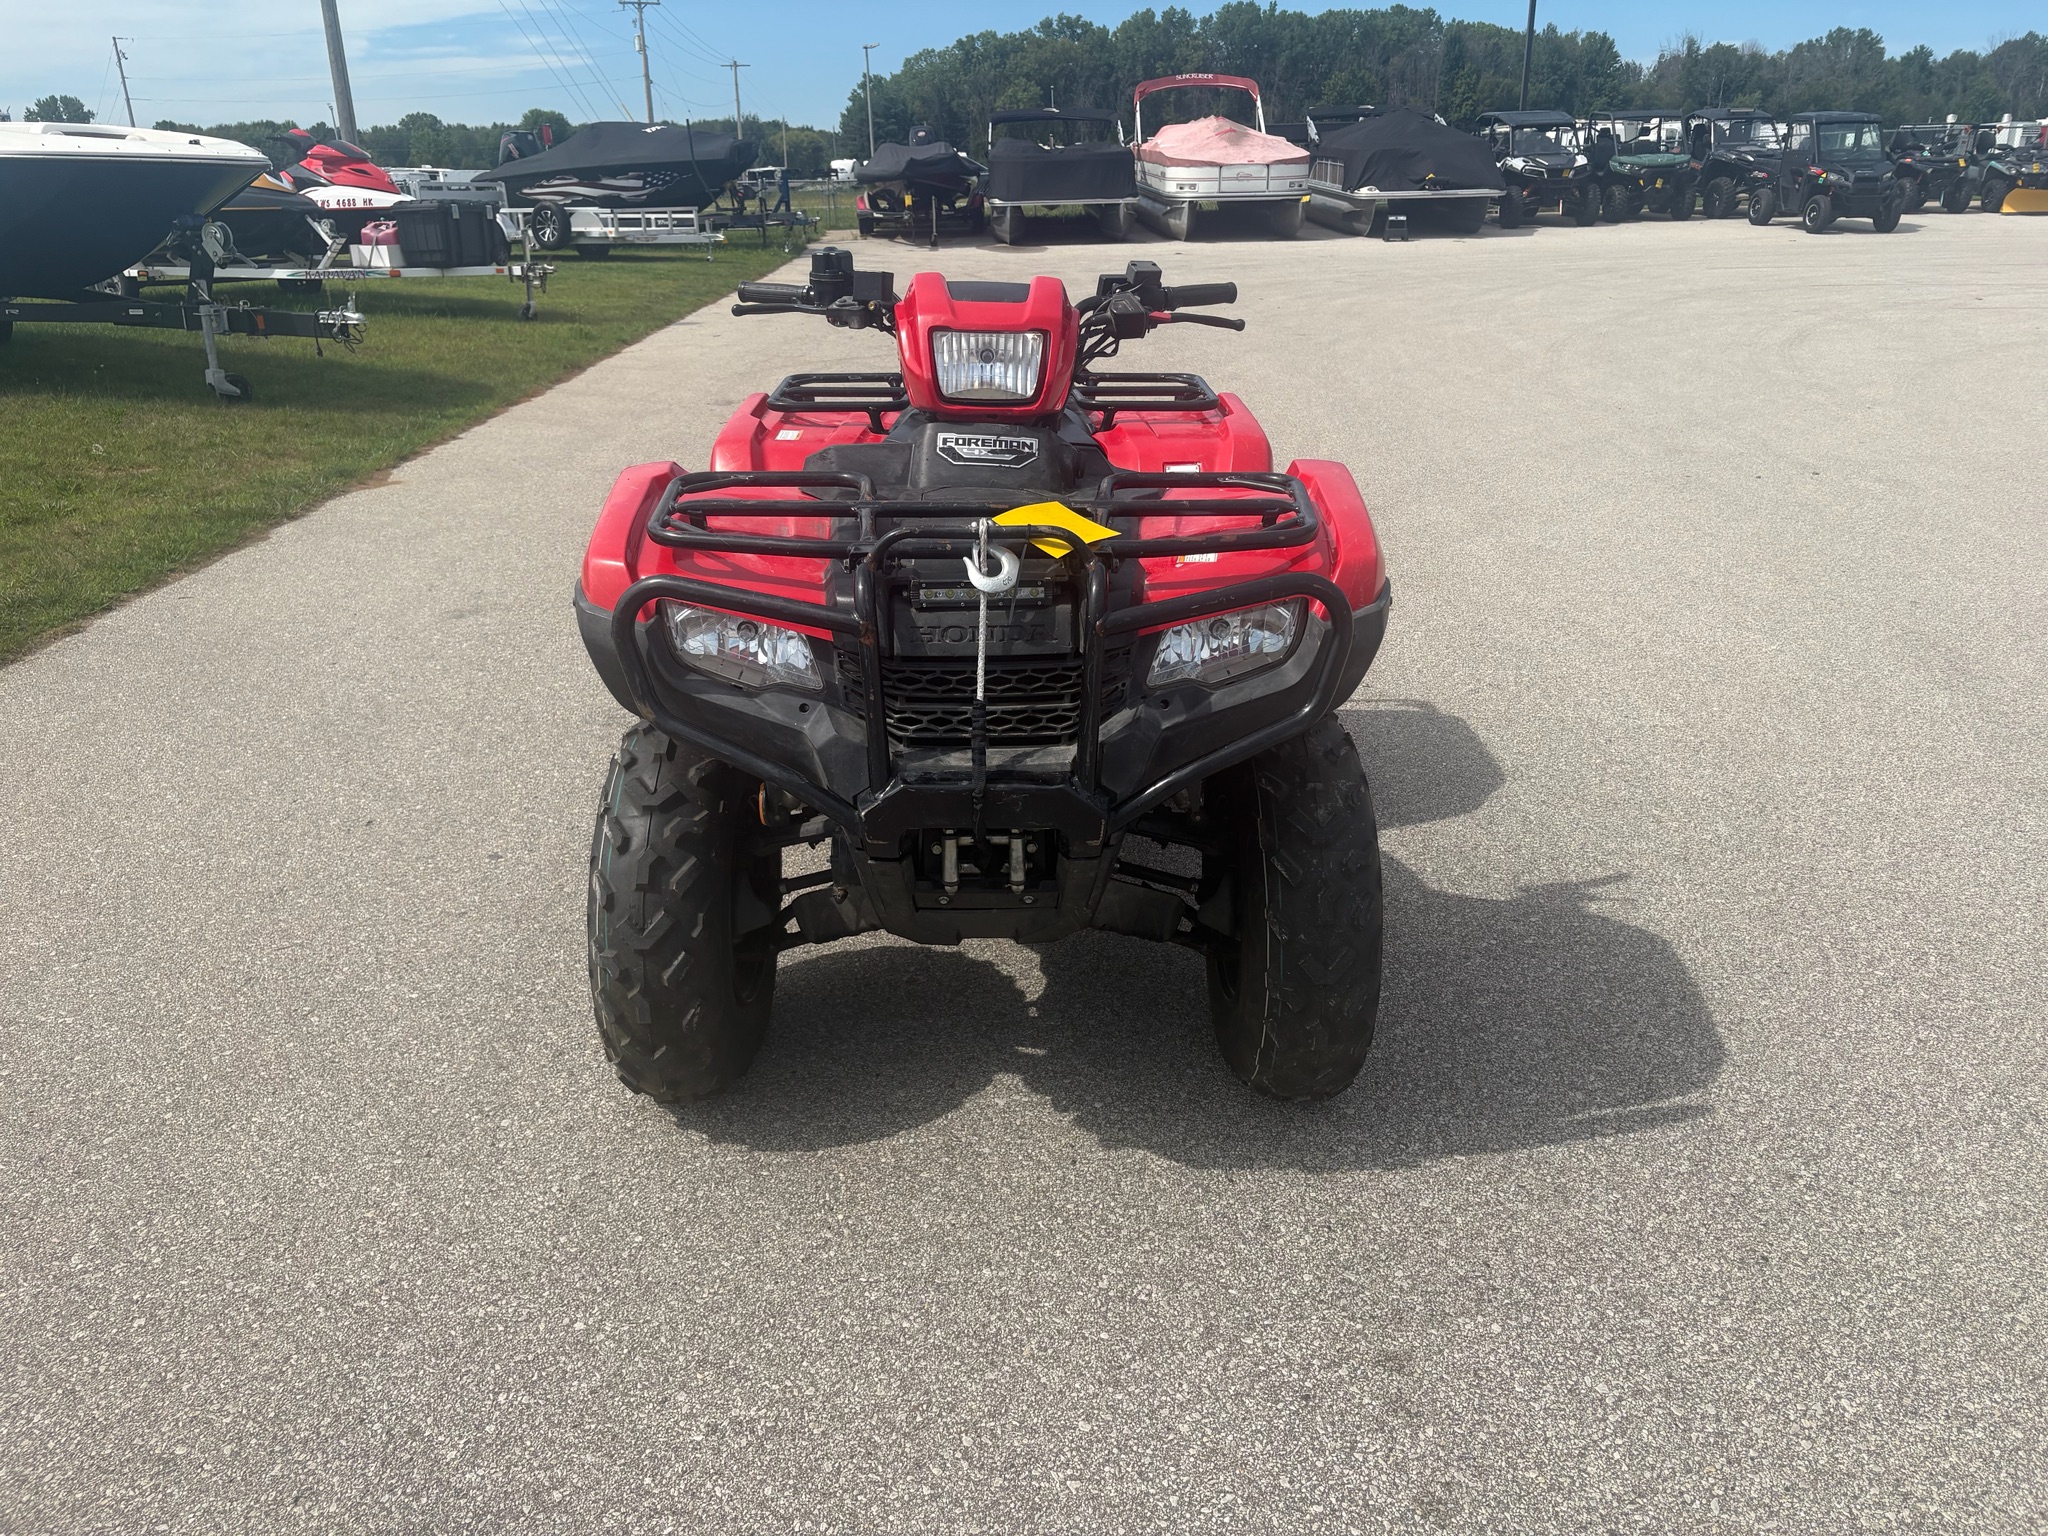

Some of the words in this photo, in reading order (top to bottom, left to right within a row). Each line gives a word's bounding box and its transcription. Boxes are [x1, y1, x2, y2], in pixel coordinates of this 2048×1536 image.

[320, 199, 331, 208] WS
[336, 198, 357, 208] 4688
[363, 198, 374, 206] HK
[305, 269, 366, 279] KARAVAN
[941, 437, 1034, 451] FOREMAN
[909, 625, 1059, 643] HONDA
